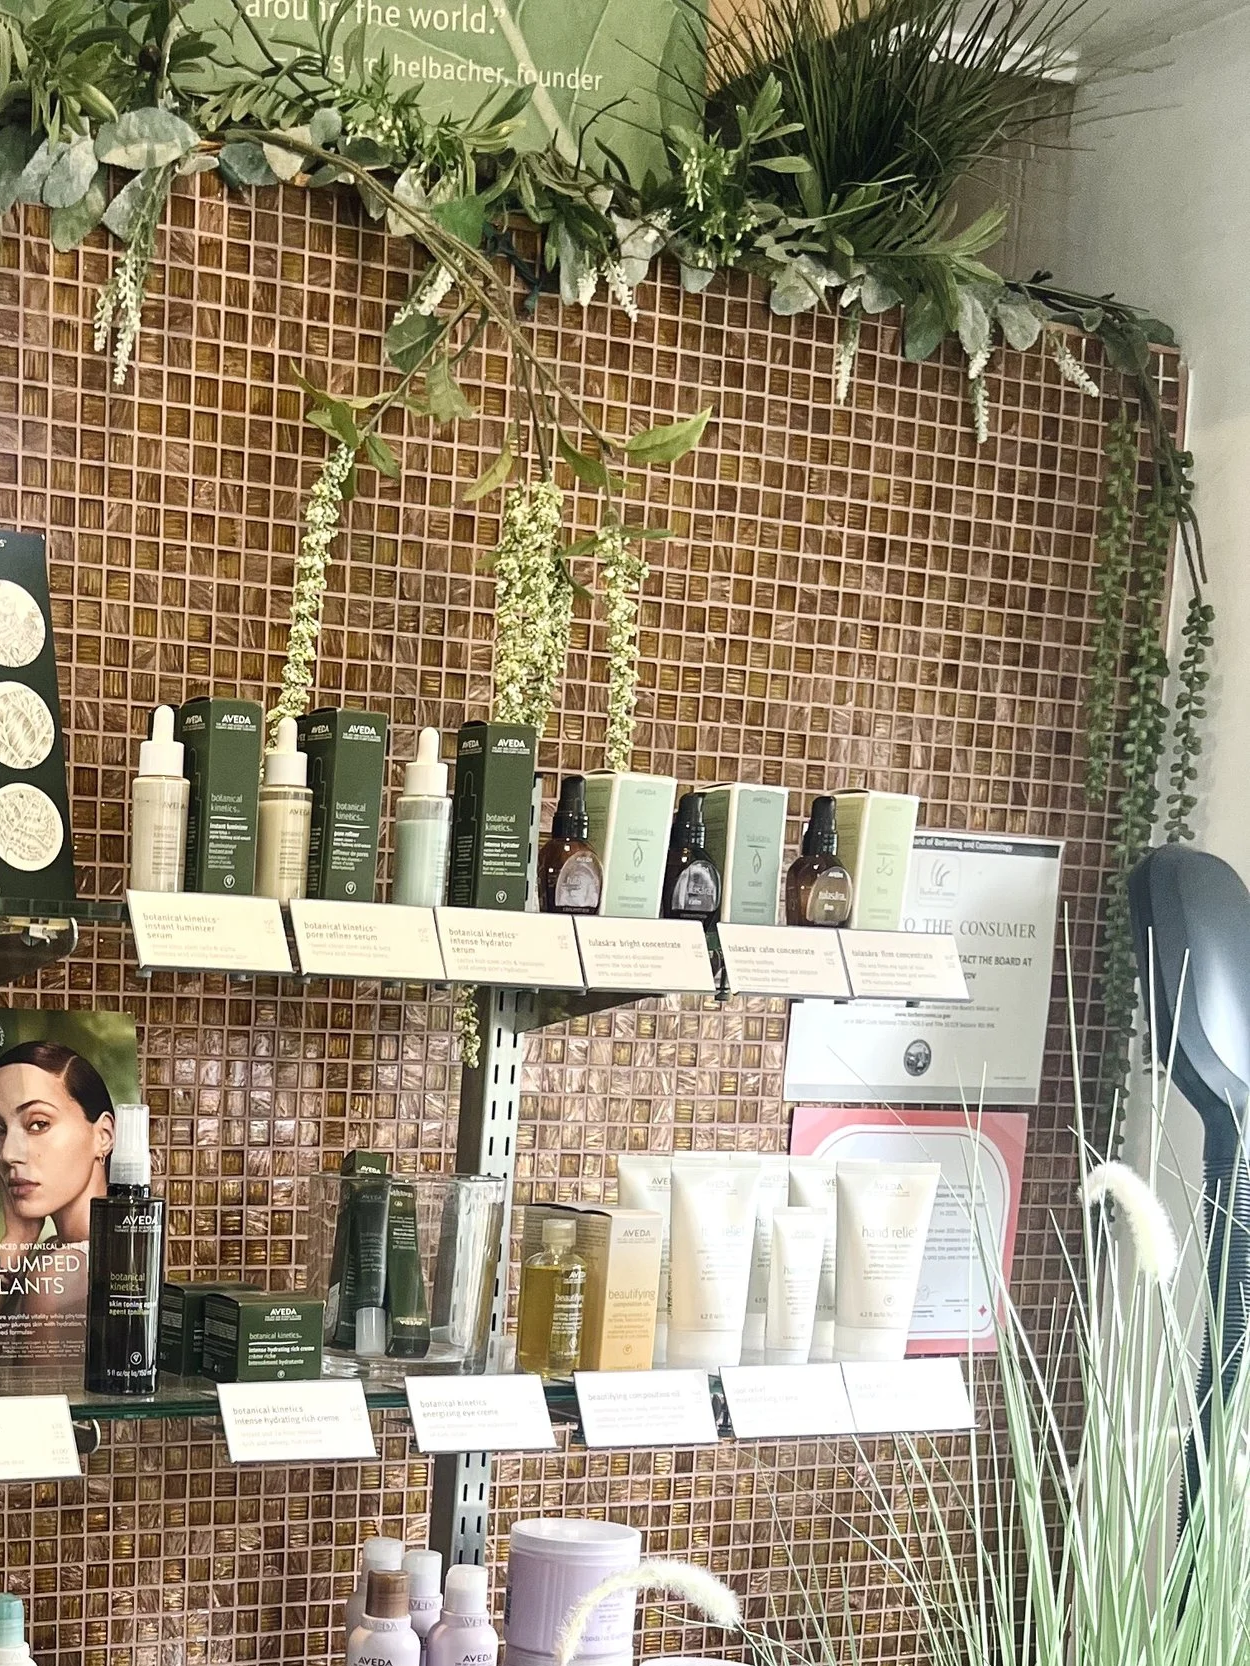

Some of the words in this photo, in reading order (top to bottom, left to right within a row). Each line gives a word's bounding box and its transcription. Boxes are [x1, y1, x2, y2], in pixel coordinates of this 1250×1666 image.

[221, 714, 252, 724] AVEDA
[485, 813, 516, 824] botanical
[922, 918, 953, 935] THE
[959, 920, 1037, 939] CONSUMER
[978, 956, 993, 965] THE
[994, 956, 1021, 967] BOARD
[1022, 958, 1032, 967] AT
[608, 1287, 657, 1301] beautifying
